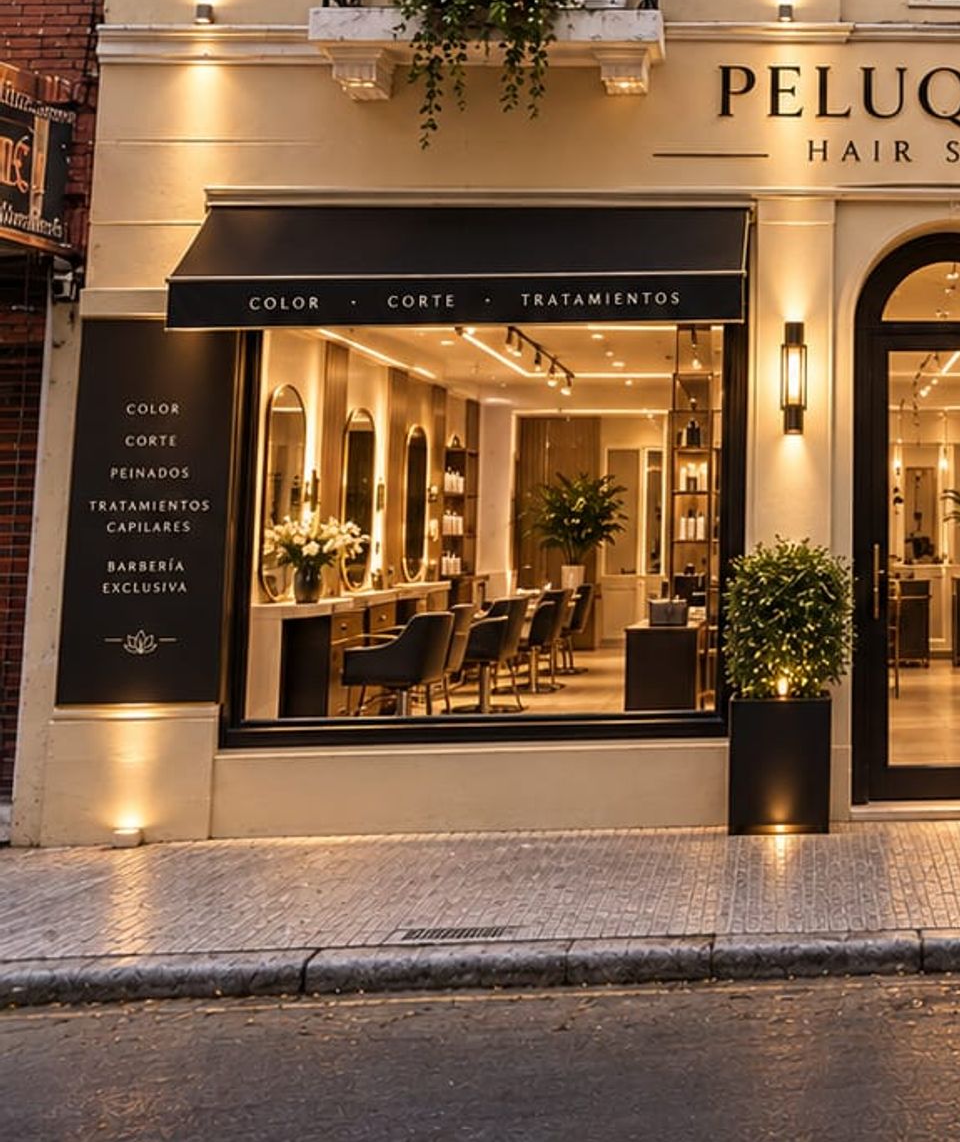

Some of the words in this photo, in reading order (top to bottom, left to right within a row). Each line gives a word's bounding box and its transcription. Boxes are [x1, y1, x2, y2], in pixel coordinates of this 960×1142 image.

[807, 139, 913, 164] HAIR
[248, 295, 320, 311] COLOR
[386, 293, 456, 309] CORTE
[520, 290, 682, 307] TRATAMIENTOS
[125, 402, 181, 416] COLOR
[124, 434, 178, 448] CORTE
[109, 466, 190, 480] PEINADOS
[89, 499, 211, 513] TRATAMIENTOS
[105, 520, 192, 534] CAPILARES
[107, 558, 186, 573] BARBERÍA
[101, 581, 188, 595] EXCLUSIVA
